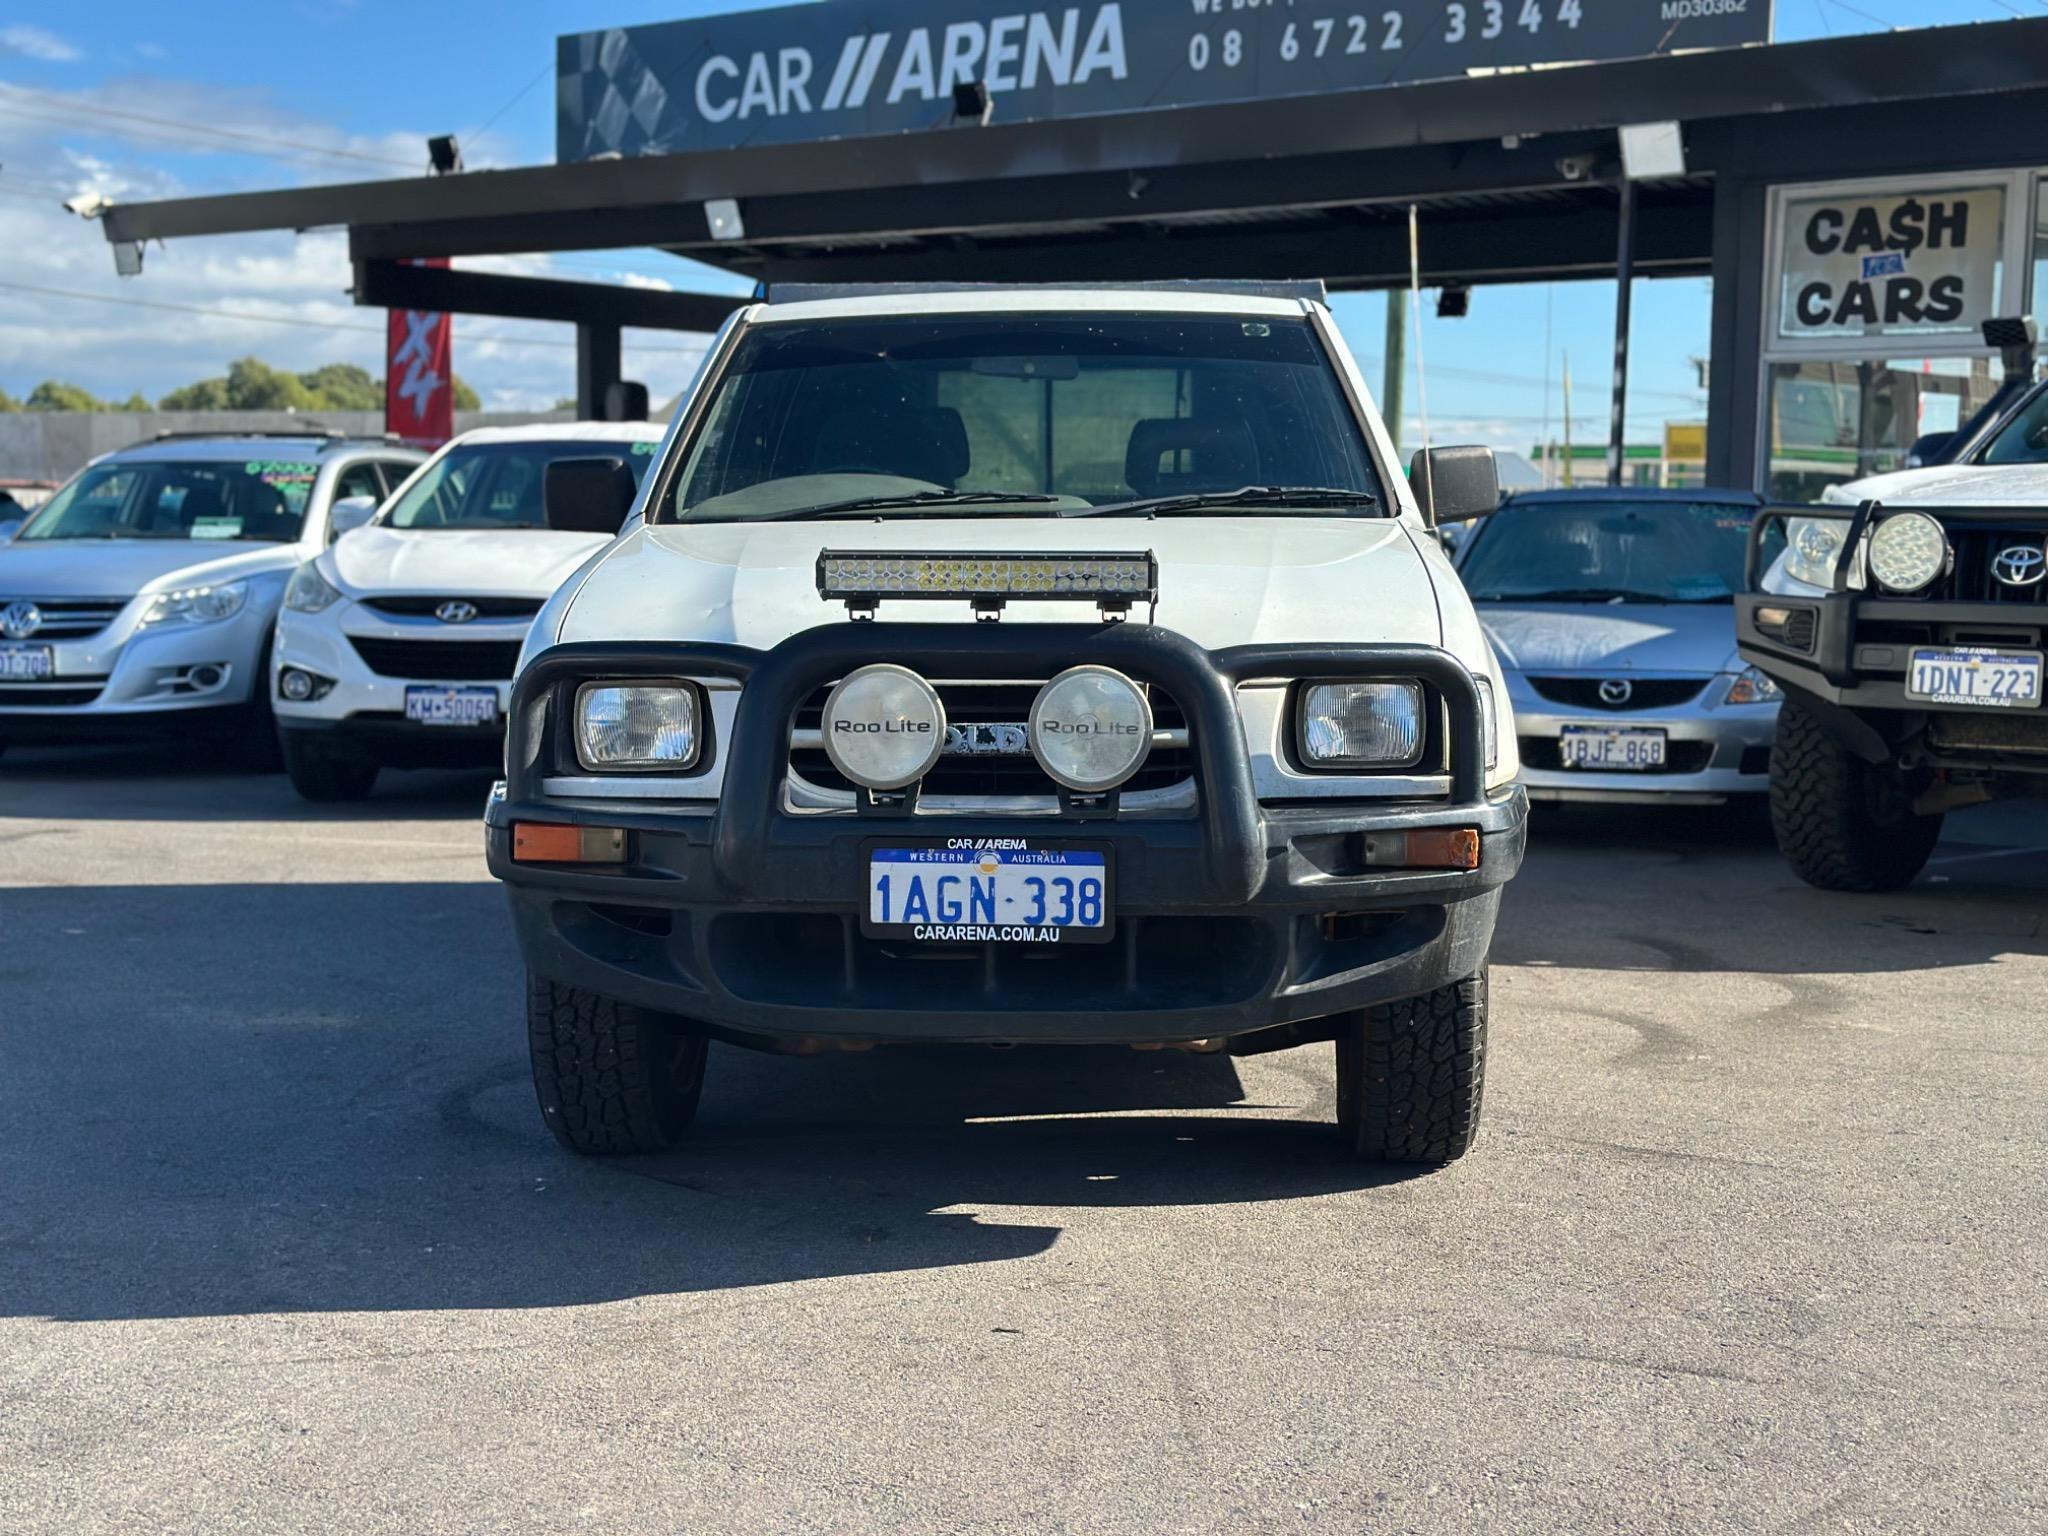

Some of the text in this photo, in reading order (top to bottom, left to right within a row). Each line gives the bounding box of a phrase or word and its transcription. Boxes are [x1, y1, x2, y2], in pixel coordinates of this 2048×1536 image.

[1188, 29, 1242, 71] 08
[1280, 10, 1403, 61] 6722
[696, 47, 813, 122] CAR
[1796, 275, 1964, 326] CARS
[835, 719, 931, 733] Roo Lite
[1043, 720, 1138, 735] Roo Lite
[947, 838, 973, 849] CAR
[910, 853, 1066, 864] WESTERN AUSTRALIA
[913, 925, 1059, 942] CARARENA.COM.AU
